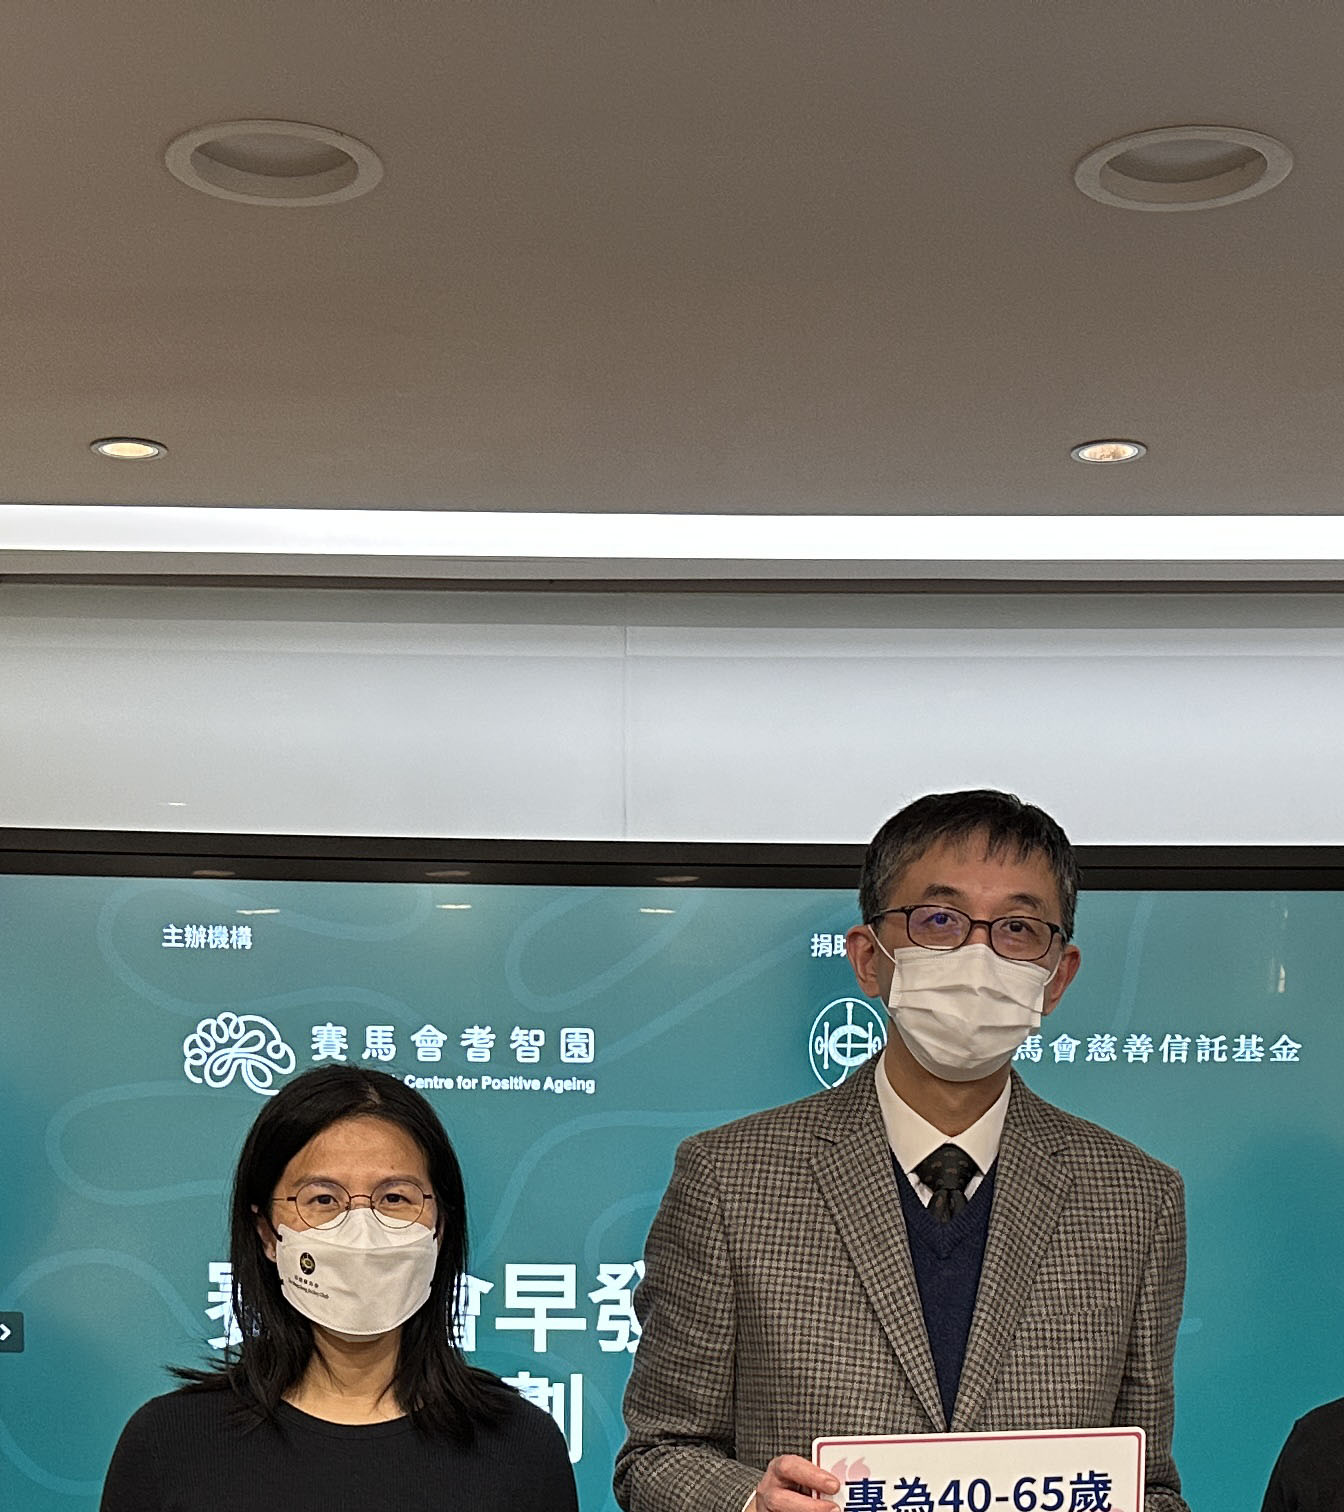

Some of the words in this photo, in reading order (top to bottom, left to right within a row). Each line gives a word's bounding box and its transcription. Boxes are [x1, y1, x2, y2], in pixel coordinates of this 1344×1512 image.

[161, 924, 253, 951] 主辦機構
[310, 1022, 596, 1064] 賽馬會耆智園
[404, 1075, 454, 1090] Centre
[457, 1075, 479, 1090] for
[482, 1075, 541, 1091] Positive
[543, 1077, 596, 1094] Ageing
